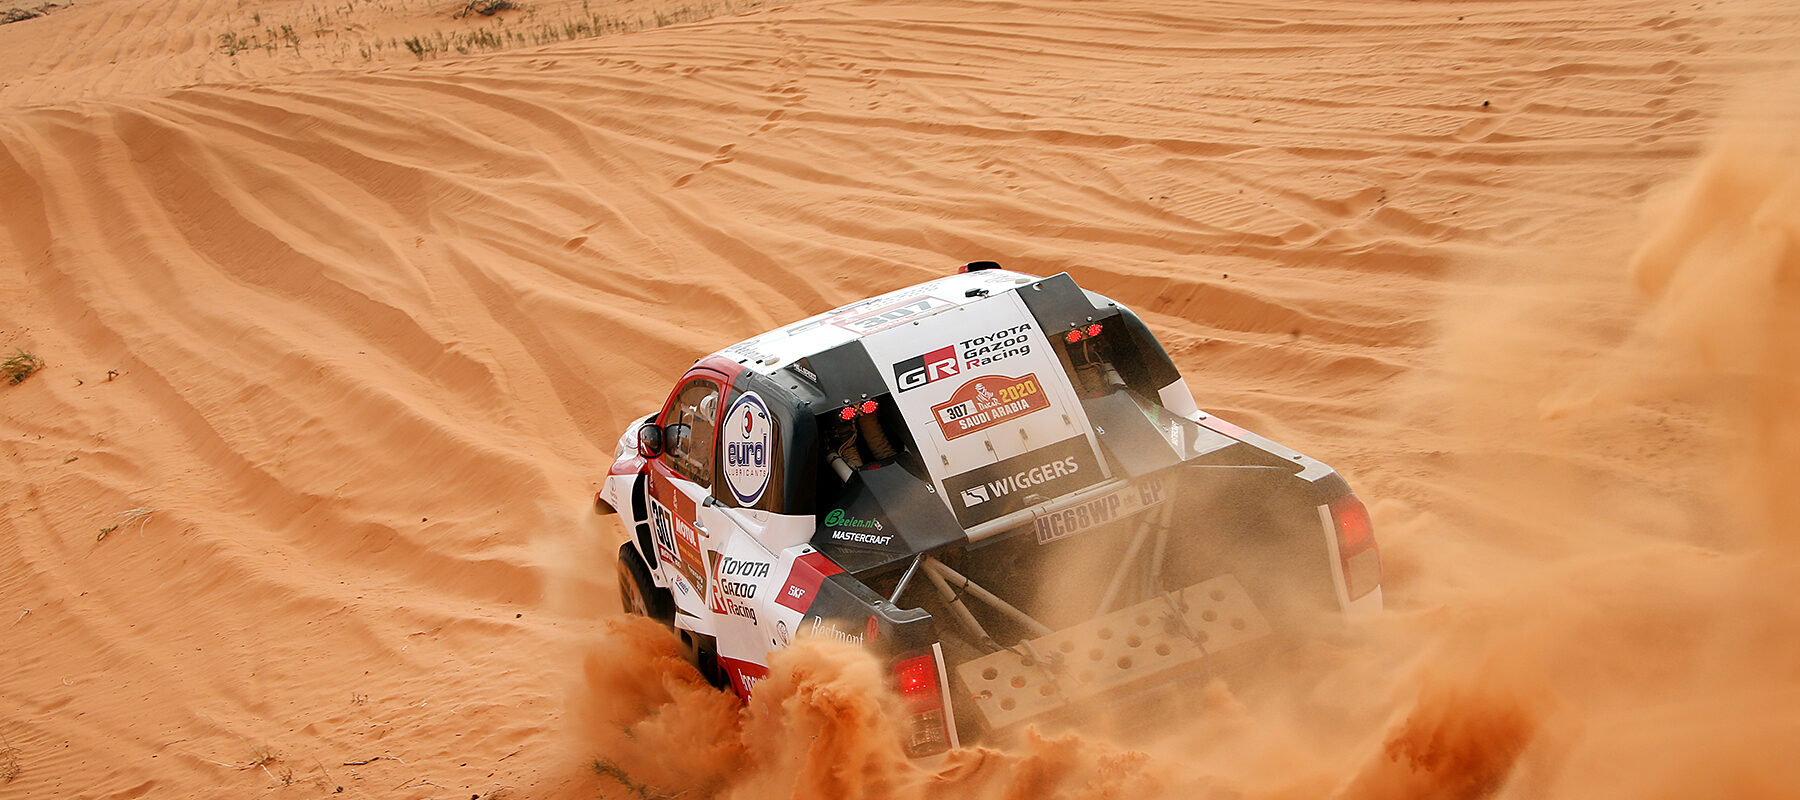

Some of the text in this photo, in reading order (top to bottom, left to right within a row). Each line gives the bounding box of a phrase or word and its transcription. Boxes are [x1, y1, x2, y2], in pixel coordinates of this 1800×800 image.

[960, 323, 1031, 349] TOYOTA
[964, 334, 1028, 359] GAZOO
[966, 345, 1030, 370] Racing
[898, 357, 958, 390] GR
[999, 381, 1037, 403] 2020
[947, 404, 969, 420] 307
[958, 399, 1030, 430] SAUDI ARABIA
[728, 433, 767, 467] eurol
[728, 469, 766, 477] LUBRICANTS
[988, 456, 1079, 498] WIGGERS
[824, 508, 876, 528] Beelen.nl
[1037, 479, 1163, 541] HC68WP GP
[675, 517, 697, 548] MOTUL
[832, 530, 892, 546] MASTERCRAFT
[721, 557, 770, 578] TOYOTA
[721, 579, 757, 599] GAZOO
[787, 585, 806, 599] SKF
[726, 598, 758, 626] Racing
